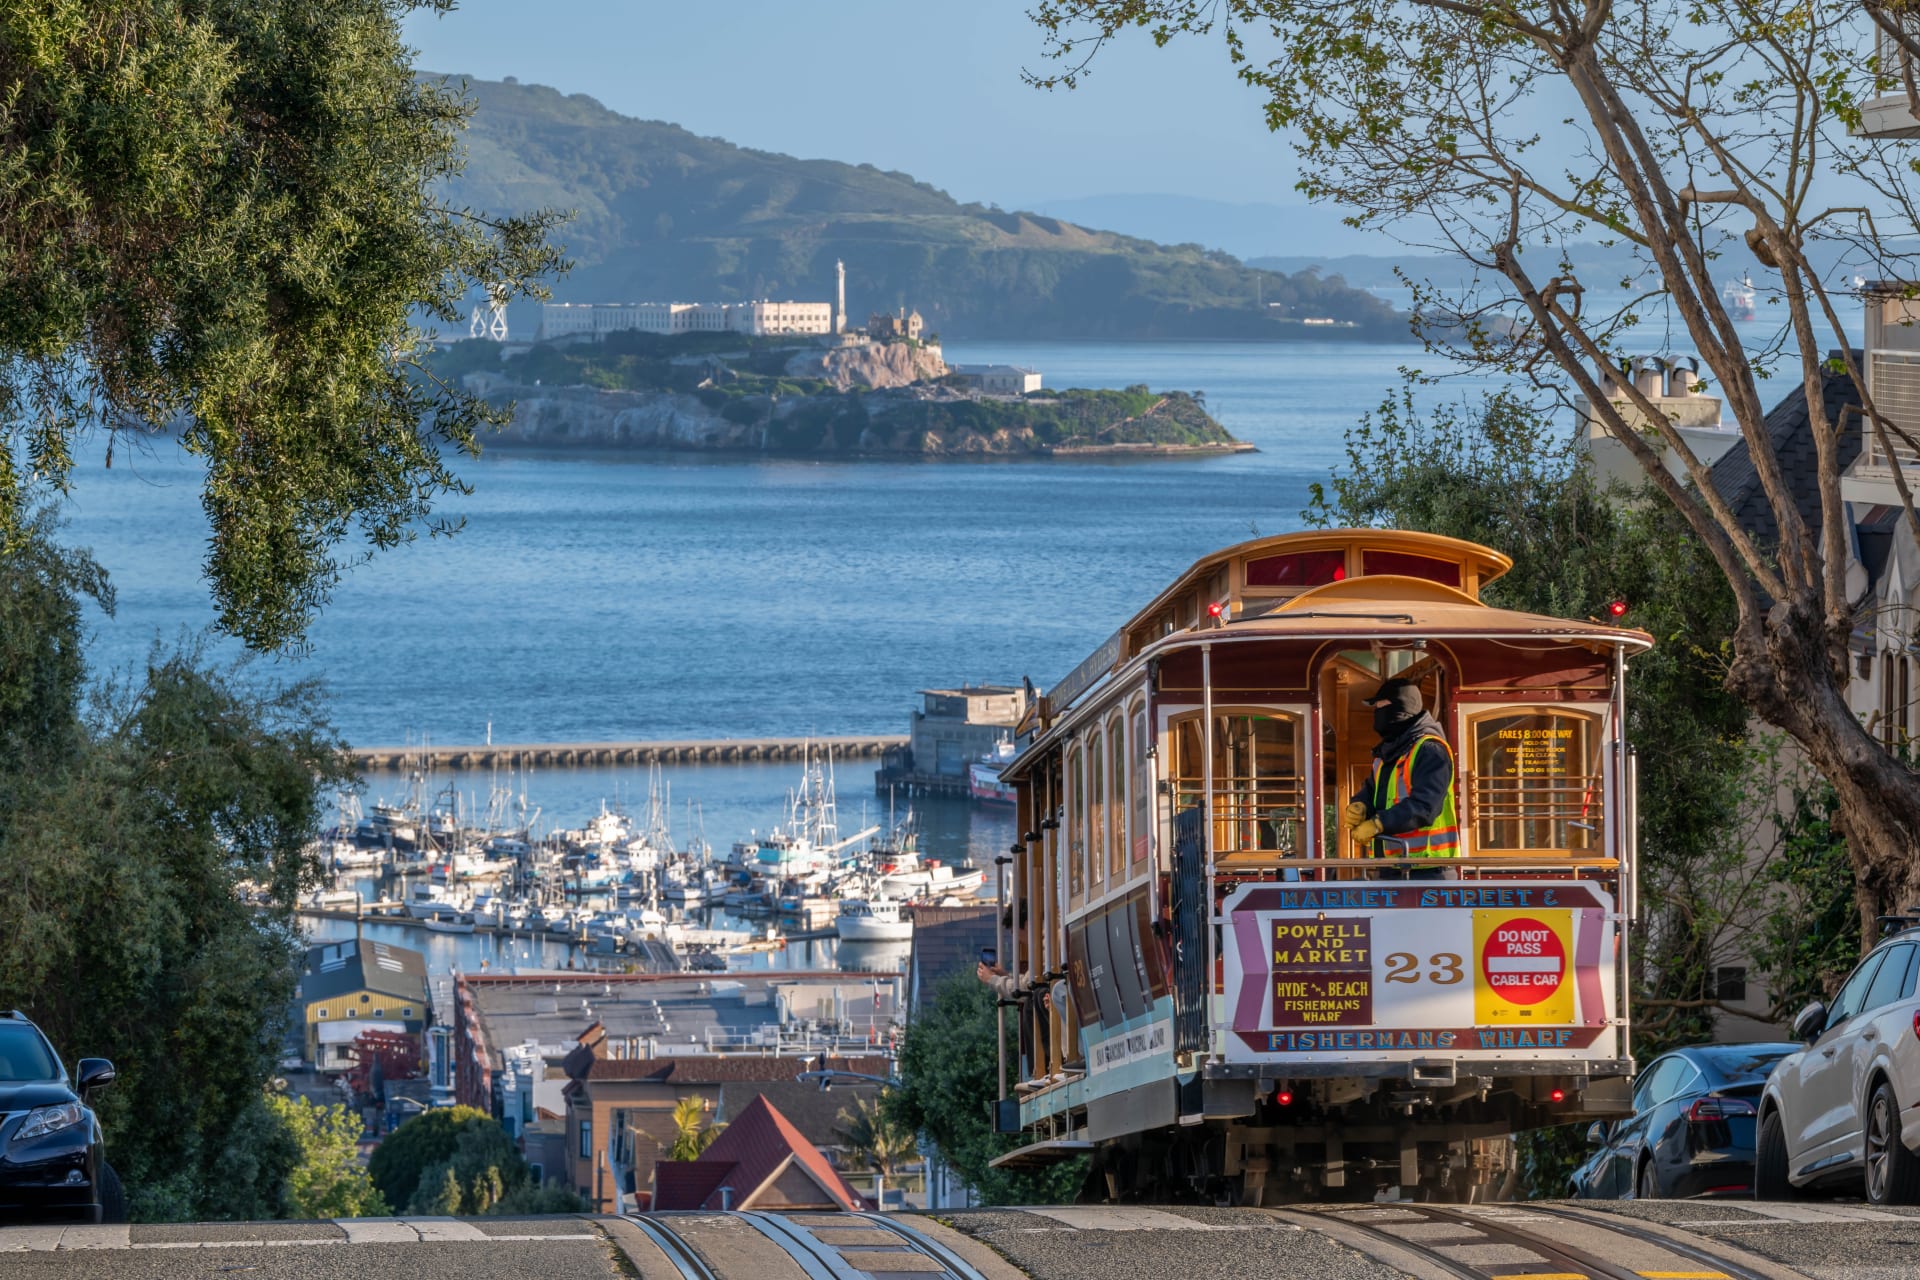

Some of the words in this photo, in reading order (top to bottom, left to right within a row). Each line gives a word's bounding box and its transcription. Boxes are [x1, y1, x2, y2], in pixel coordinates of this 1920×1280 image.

[1499, 729, 1522, 739] FARES
[1280, 888, 1399, 909] MARKET
[1420, 888, 1533, 907] STREET
[1543, 888, 1559, 906] &
[1276, 924, 1367, 939] POWELL
[1498, 930, 1519, 942] DO
[1521, 930, 1550, 942] NOT
[1300, 938, 1344, 949] AND
[1507, 942, 1542, 954] PASS
[1275, 949, 1368, 964] MARKET
[1384, 951, 1465, 985] 23
[1491, 974, 1531, 986] CABLE
[1533, 974, 1558, 986] CAR
[1277, 982, 1309, 997] HYDE
[1328, 981, 1368, 996] BEACH
[1284, 999, 1360, 1011] FISHERMANS
[1302, 1011, 1343, 1022] WHARF
[1267, 1031, 1455, 1051] FISHERMANS
[1478, 1029, 1574, 1049] WHARF
